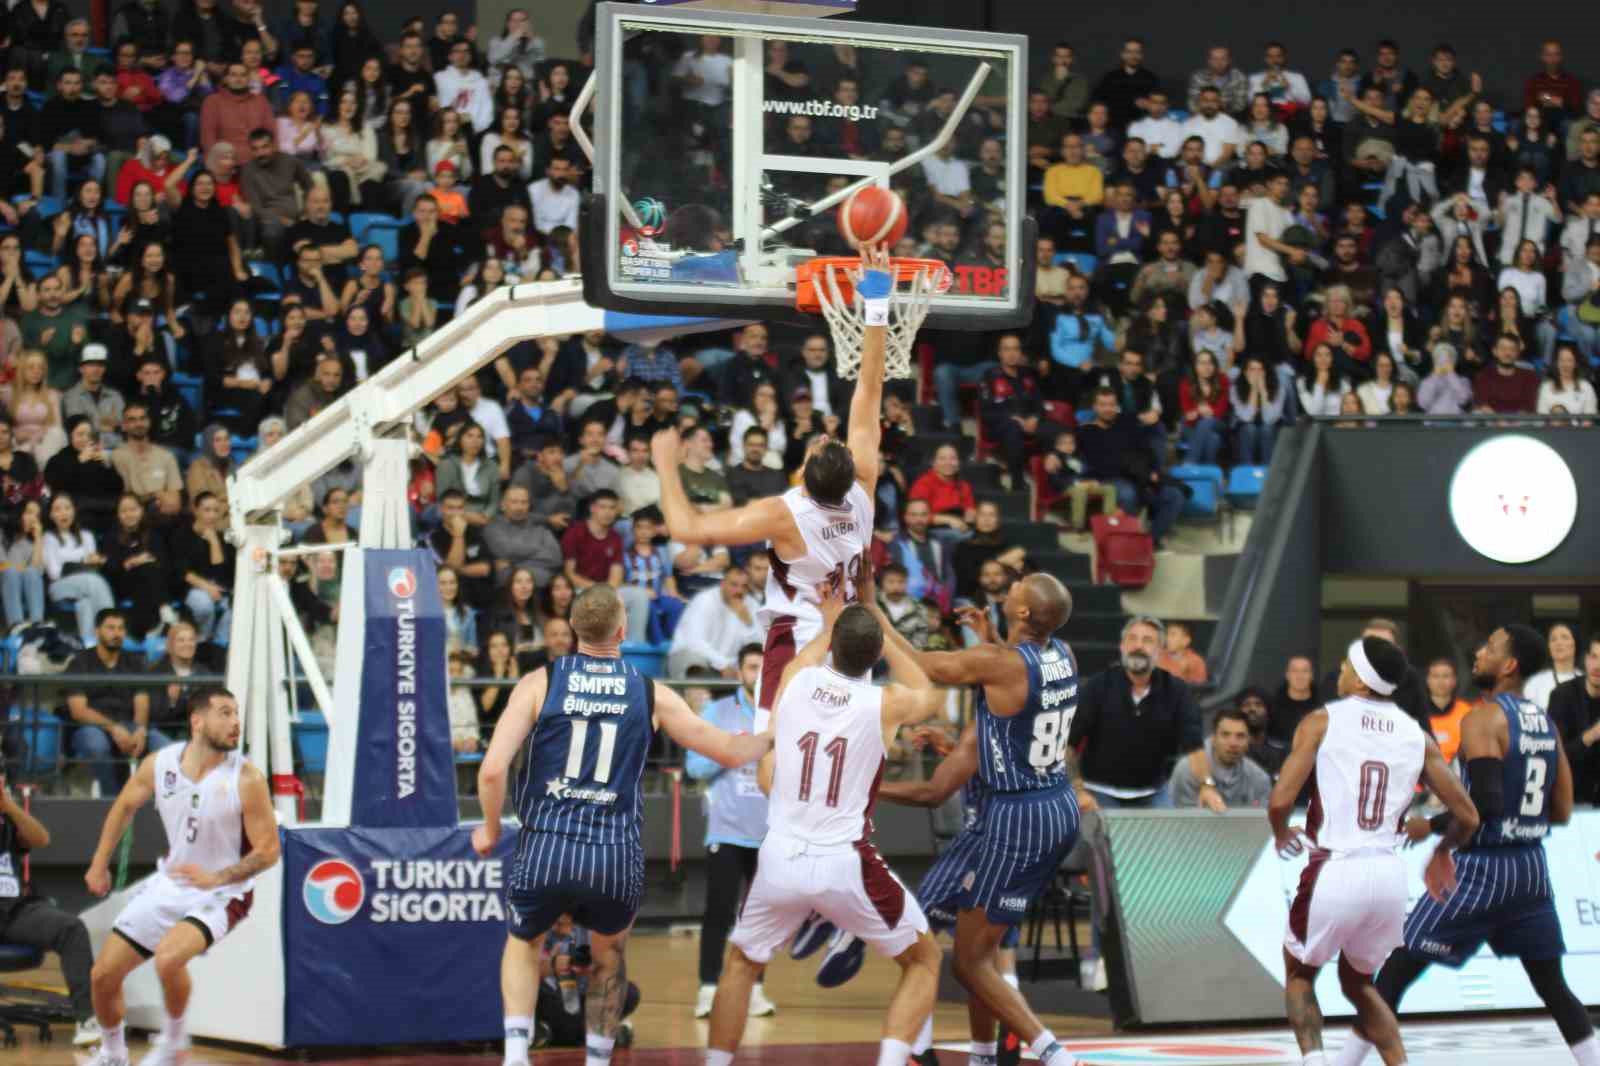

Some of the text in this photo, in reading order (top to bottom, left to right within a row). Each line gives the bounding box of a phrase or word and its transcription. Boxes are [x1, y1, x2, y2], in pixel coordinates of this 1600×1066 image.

[761, 99, 879, 121] www.tbf.org.tr
[955, 265, 1009, 296] TBF
[563, 695, 628, 716] Bilyoner
[564, 719, 618, 783] 11
[797, 731, 849, 808] 11
[1358, 760, 1389, 831] 0
[1519, 757, 1547, 816] 3
[187, 816, 199, 844] 5
